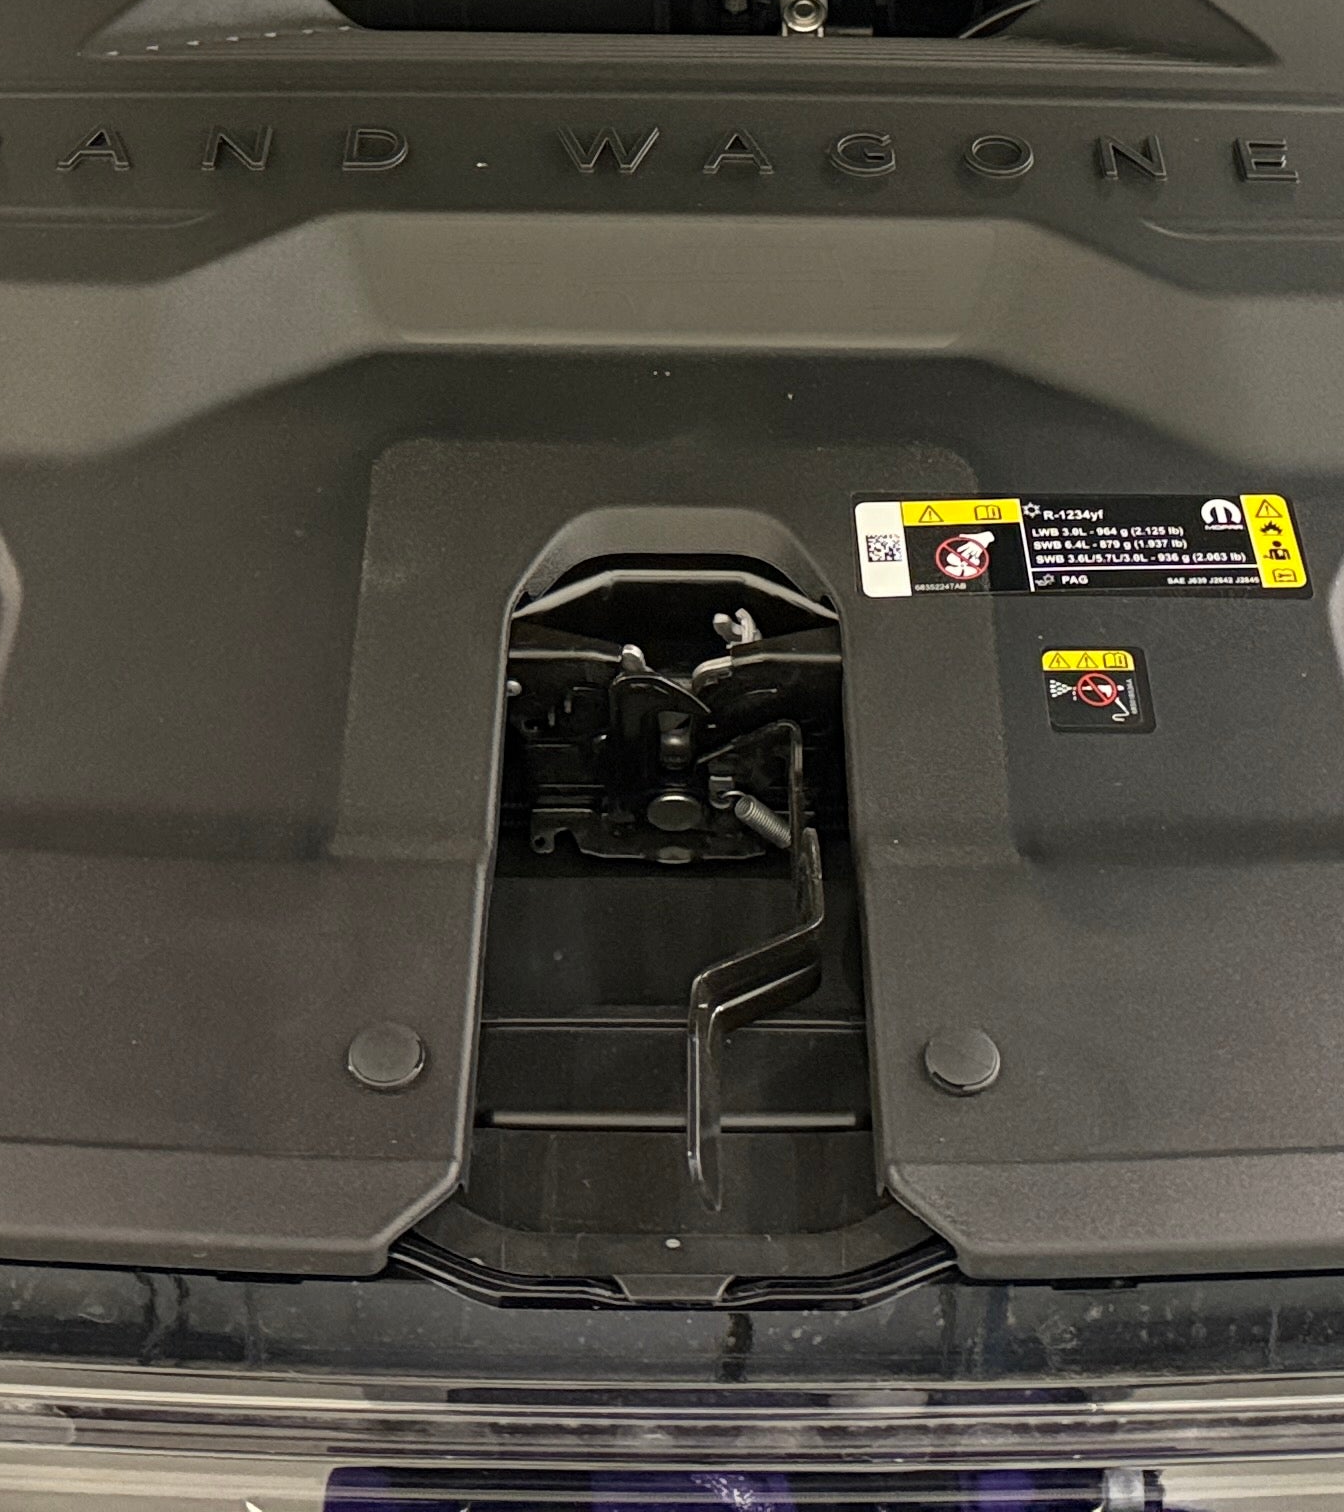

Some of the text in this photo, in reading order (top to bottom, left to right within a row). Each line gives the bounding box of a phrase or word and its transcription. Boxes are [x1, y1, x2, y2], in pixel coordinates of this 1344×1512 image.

[1043, 509, 1104, 522] R-1234yf
[1031, 528, 1060, 537] LWB
[1062, 527, 1087, 537] 3.0L
[1096, 527, 1117, 536] 964
[1120, 528, 1128, 538] g
[1131, 526, 1166, 537] (2.125
[1167, 526, 1184, 537] lb)
[1033, 540, 1062, 550] SWB
[1064, 540, 1090, 549] 6.4L
[1123, 541, 1132, 551] g
[1134, 539, 1169, 550] (1.937
[1171, 538, 1188, 550] lb)
[1036, 555, 1065, 564] SWB
[1158, 553, 1180, 562] 936
[1182, 554, 1191, 564] g
[1230, 552, 1247, 562] lb)
[1061, 574, 1089, 585] PAG
